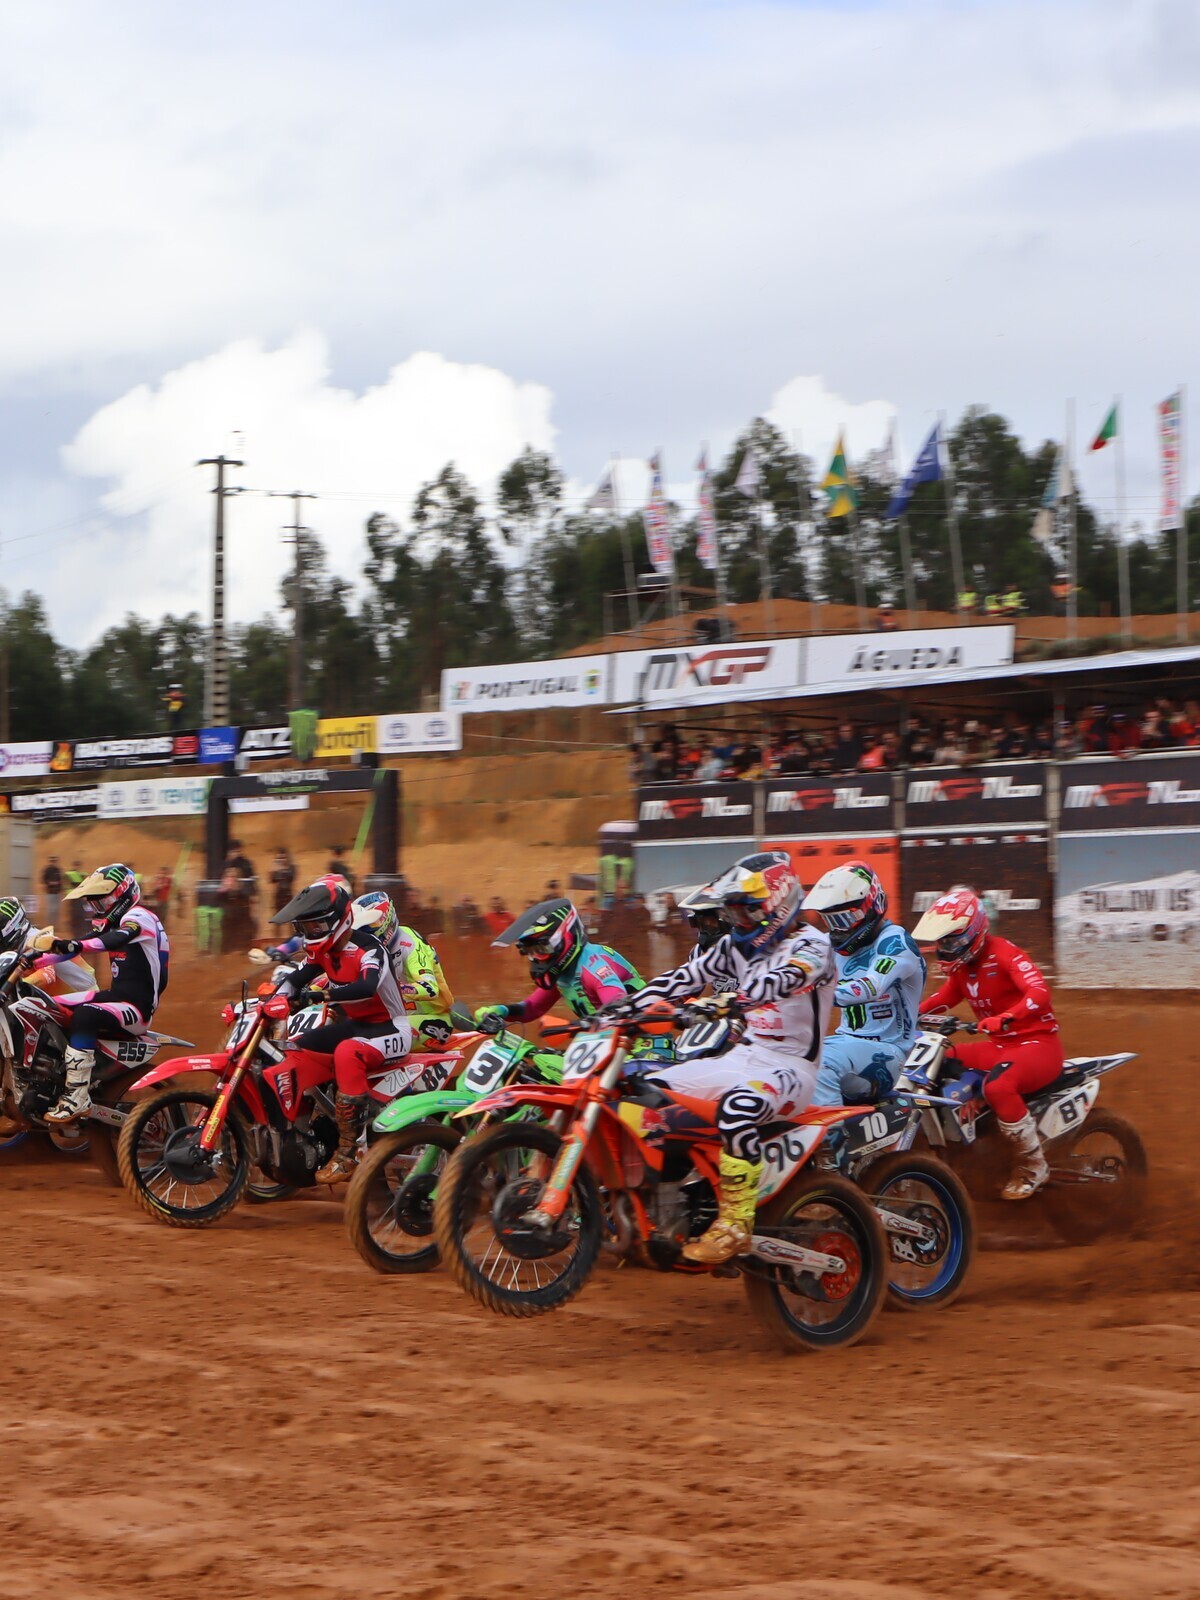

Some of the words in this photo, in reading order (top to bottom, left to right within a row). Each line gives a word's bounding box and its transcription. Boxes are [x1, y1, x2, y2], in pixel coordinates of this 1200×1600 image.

[646, 646, 774, 690] MXGP
[475, 675, 579, 699] PORTUGAL
[288, 1012, 320, 1037] 84
[117, 1041, 147, 1062] 259
[421, 1063, 450, 1092] 84
[466, 1051, 504, 1086] 3
[1058, 1091, 1090, 1125] 87
[858, 1111, 889, 1143] 10
[764, 1133, 805, 1174] 96
